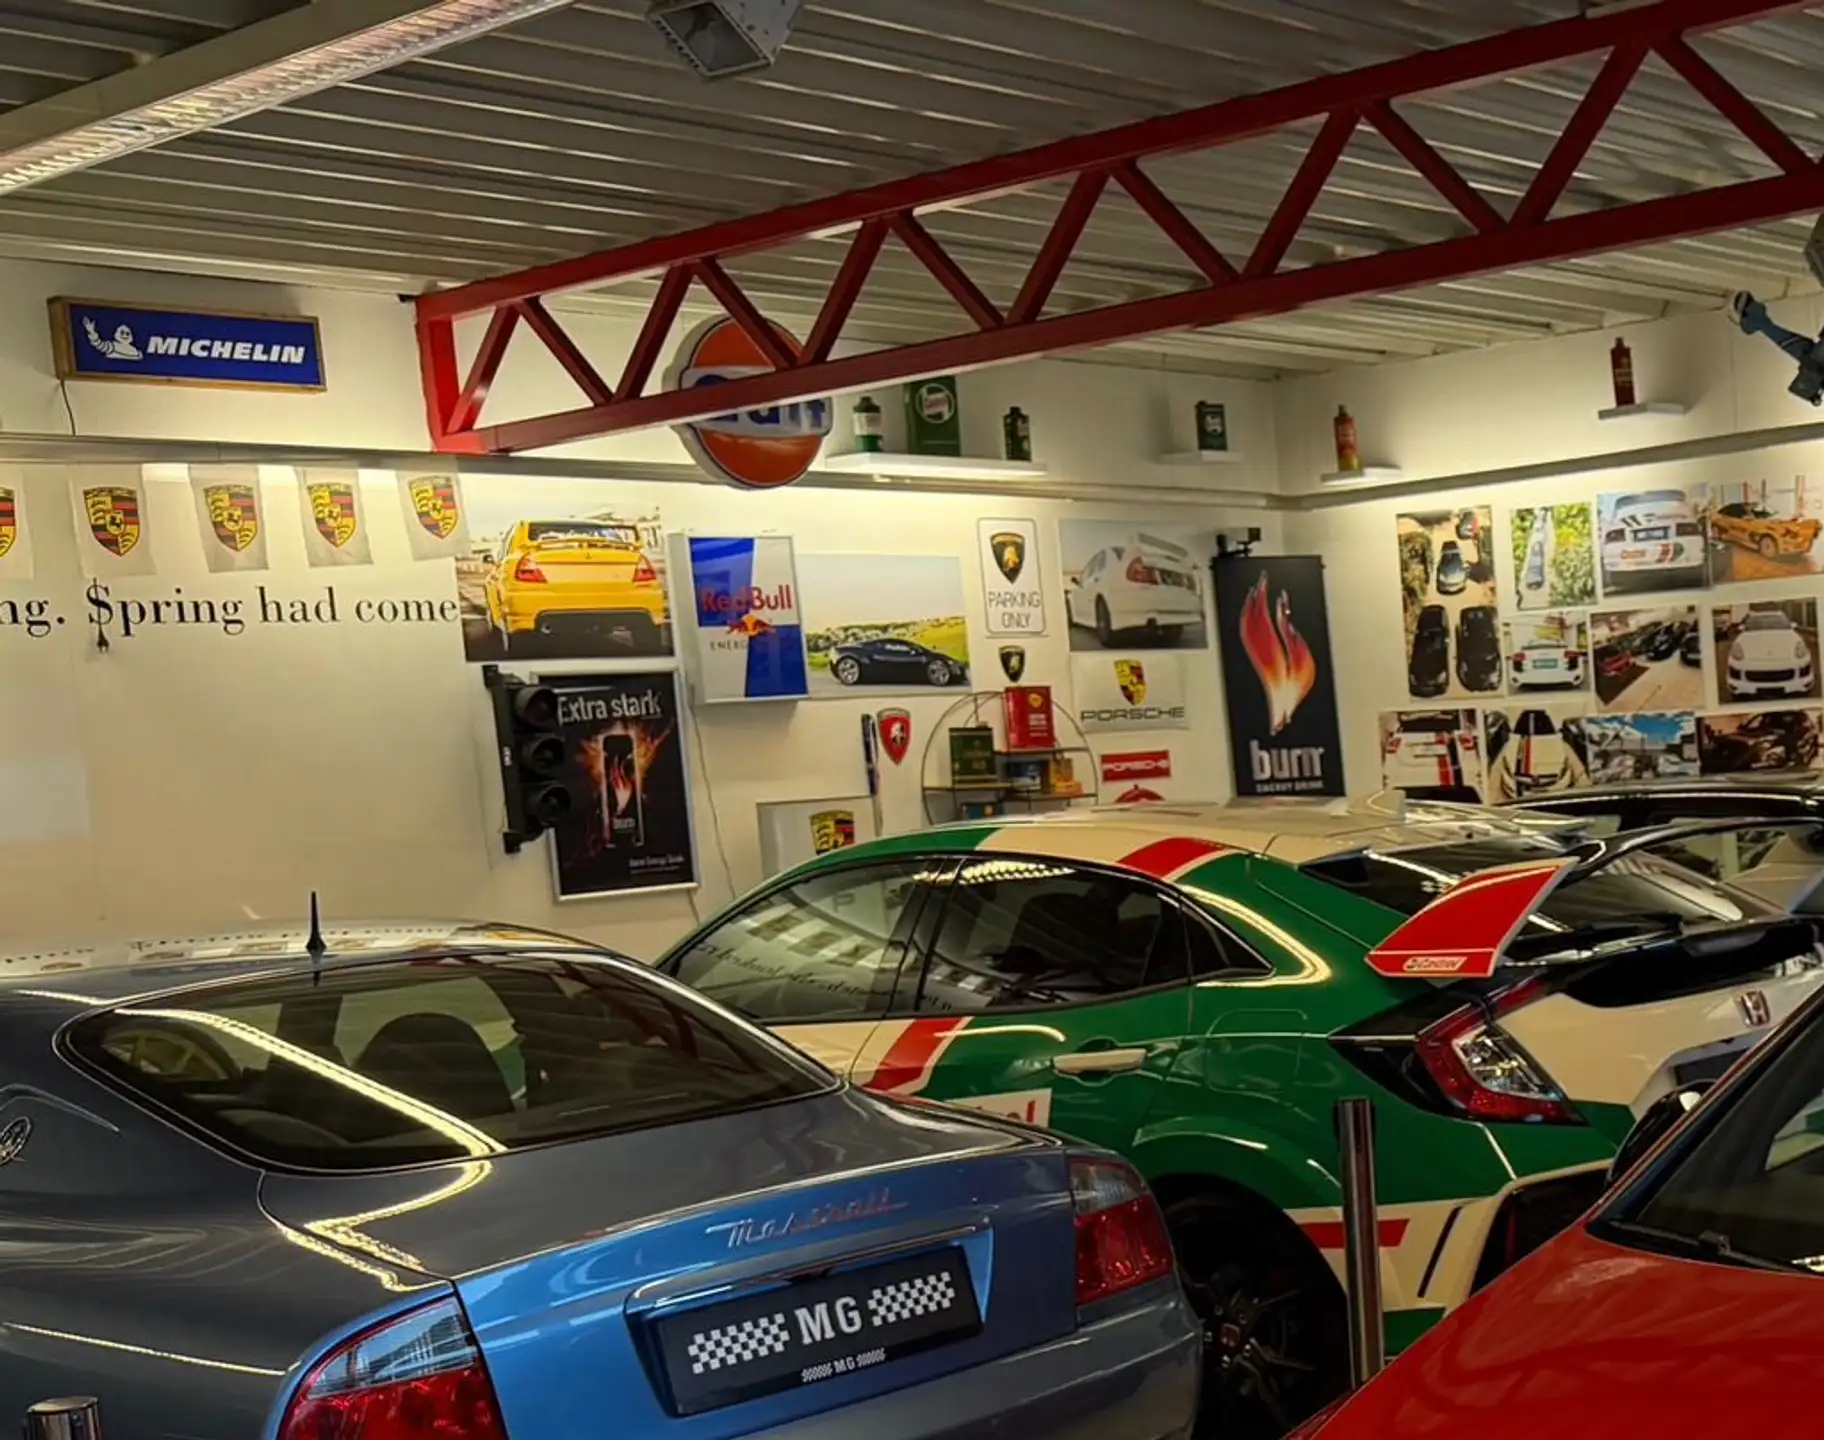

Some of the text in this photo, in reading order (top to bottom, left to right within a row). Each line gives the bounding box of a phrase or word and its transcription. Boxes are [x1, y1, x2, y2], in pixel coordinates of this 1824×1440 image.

[147, 335, 305, 364] MICHELIN
[255, 586, 340, 624] had
[354, 599, 459, 624] come
[988, 591, 1041, 609] PARKING
[1001, 612, 1031, 629] ONLY
[557, 694, 608, 726] Extra
[1080, 706, 1186, 722] PORSCHE
[1249, 739, 1323, 780] burn
[794, 1296, 863, 1345] MG
[834, 1356, 856, 1374] MG
